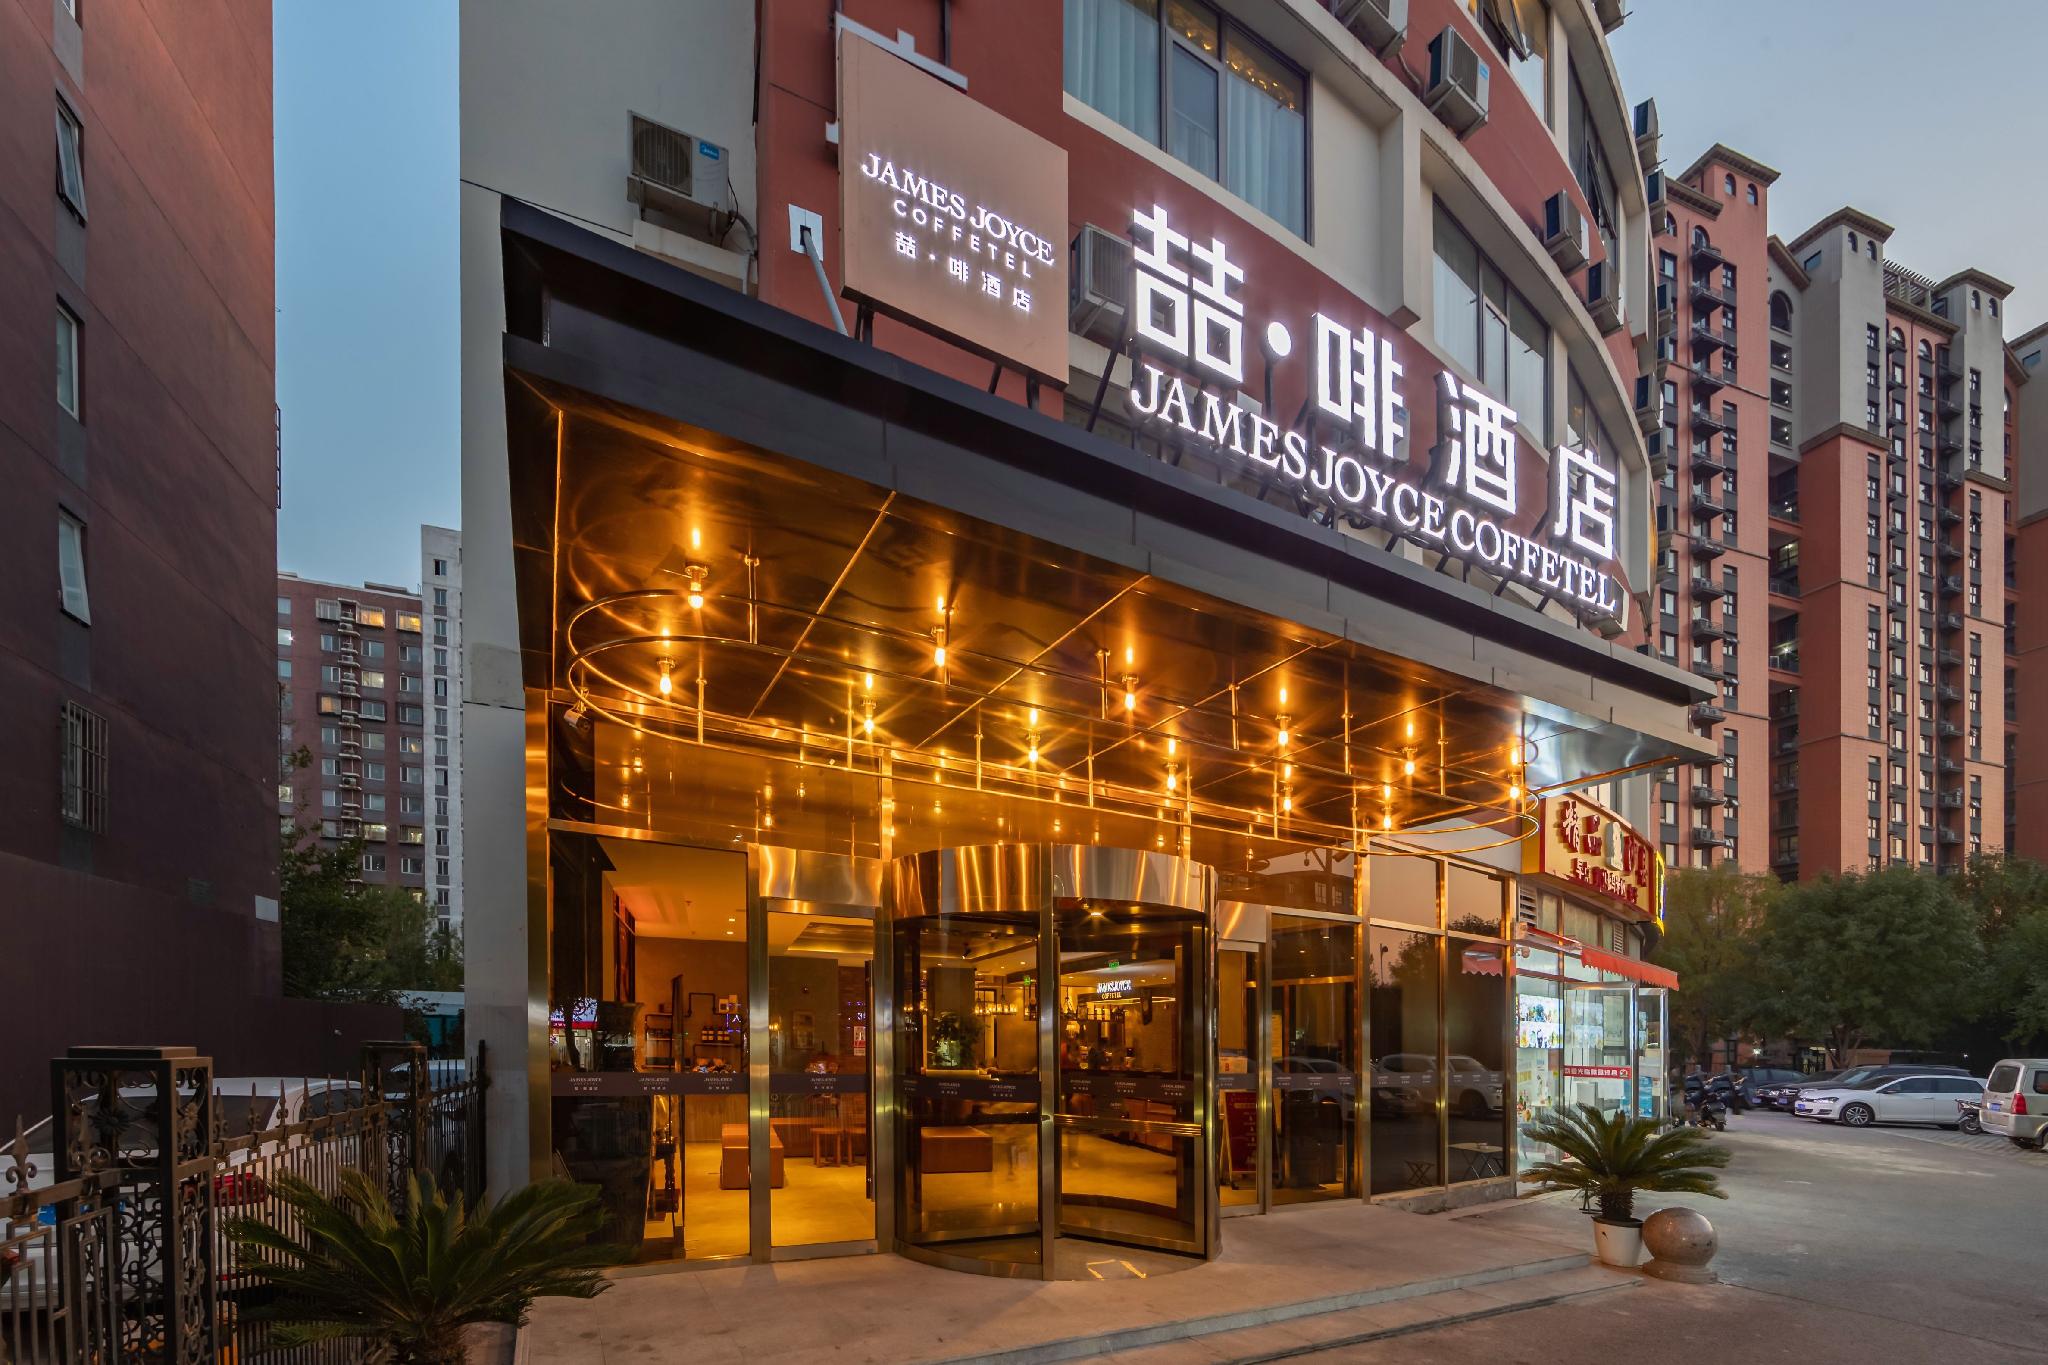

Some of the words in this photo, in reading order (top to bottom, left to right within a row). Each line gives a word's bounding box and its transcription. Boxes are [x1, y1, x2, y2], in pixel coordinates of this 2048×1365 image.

[861, 153, 965, 220] JAMES
[970, 205, 1054, 265] JOYCE
[893, 199, 1032, 277] COFFETEL
[1131, 364, 1307, 480] JAMES
[1310, 446, 1446, 538] JOYCE
[1451, 507, 1617, 612] COFFETEL
